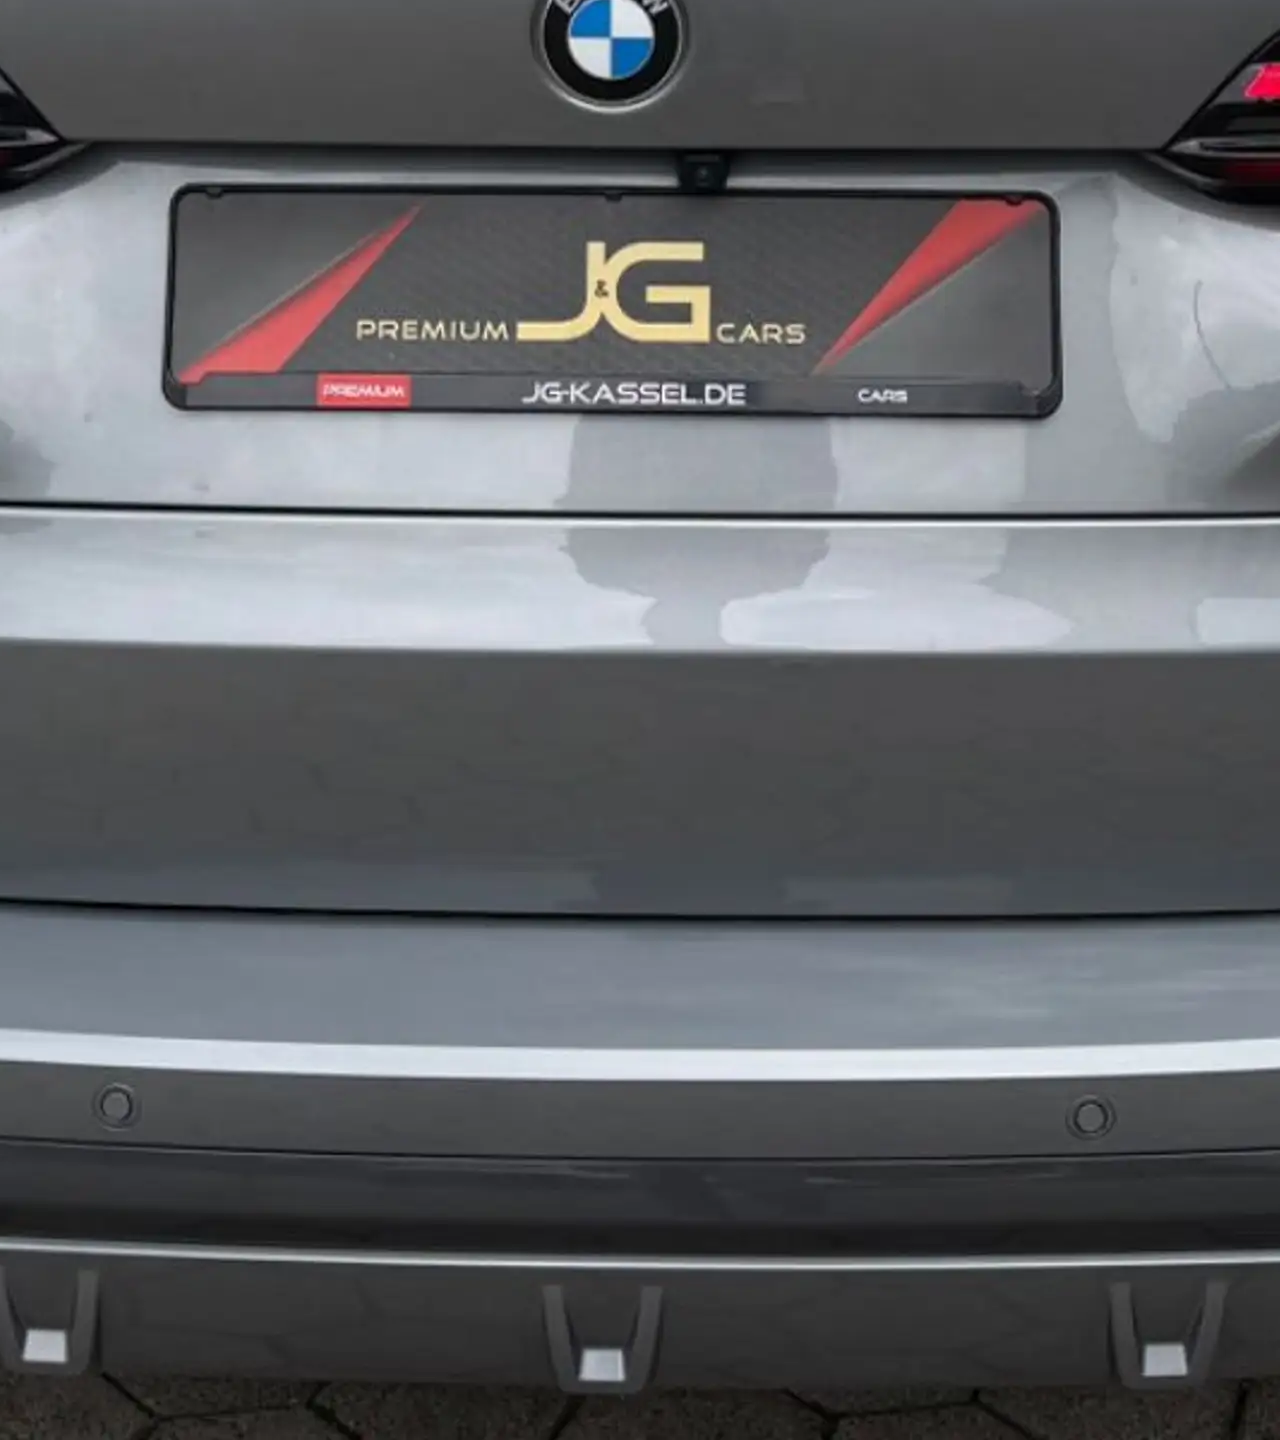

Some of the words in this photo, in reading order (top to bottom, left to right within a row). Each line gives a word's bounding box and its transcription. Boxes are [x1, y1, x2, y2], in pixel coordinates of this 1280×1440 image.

[356, 319, 510, 341] PREMIUM
[517, 241, 711, 343] J&G
[716, 322, 807, 345] CARS
[323, 383, 405, 399] PREMIUM
[522, 381, 747, 405] JG-KASSEL.DE
[858, 388, 908, 404] CARS
